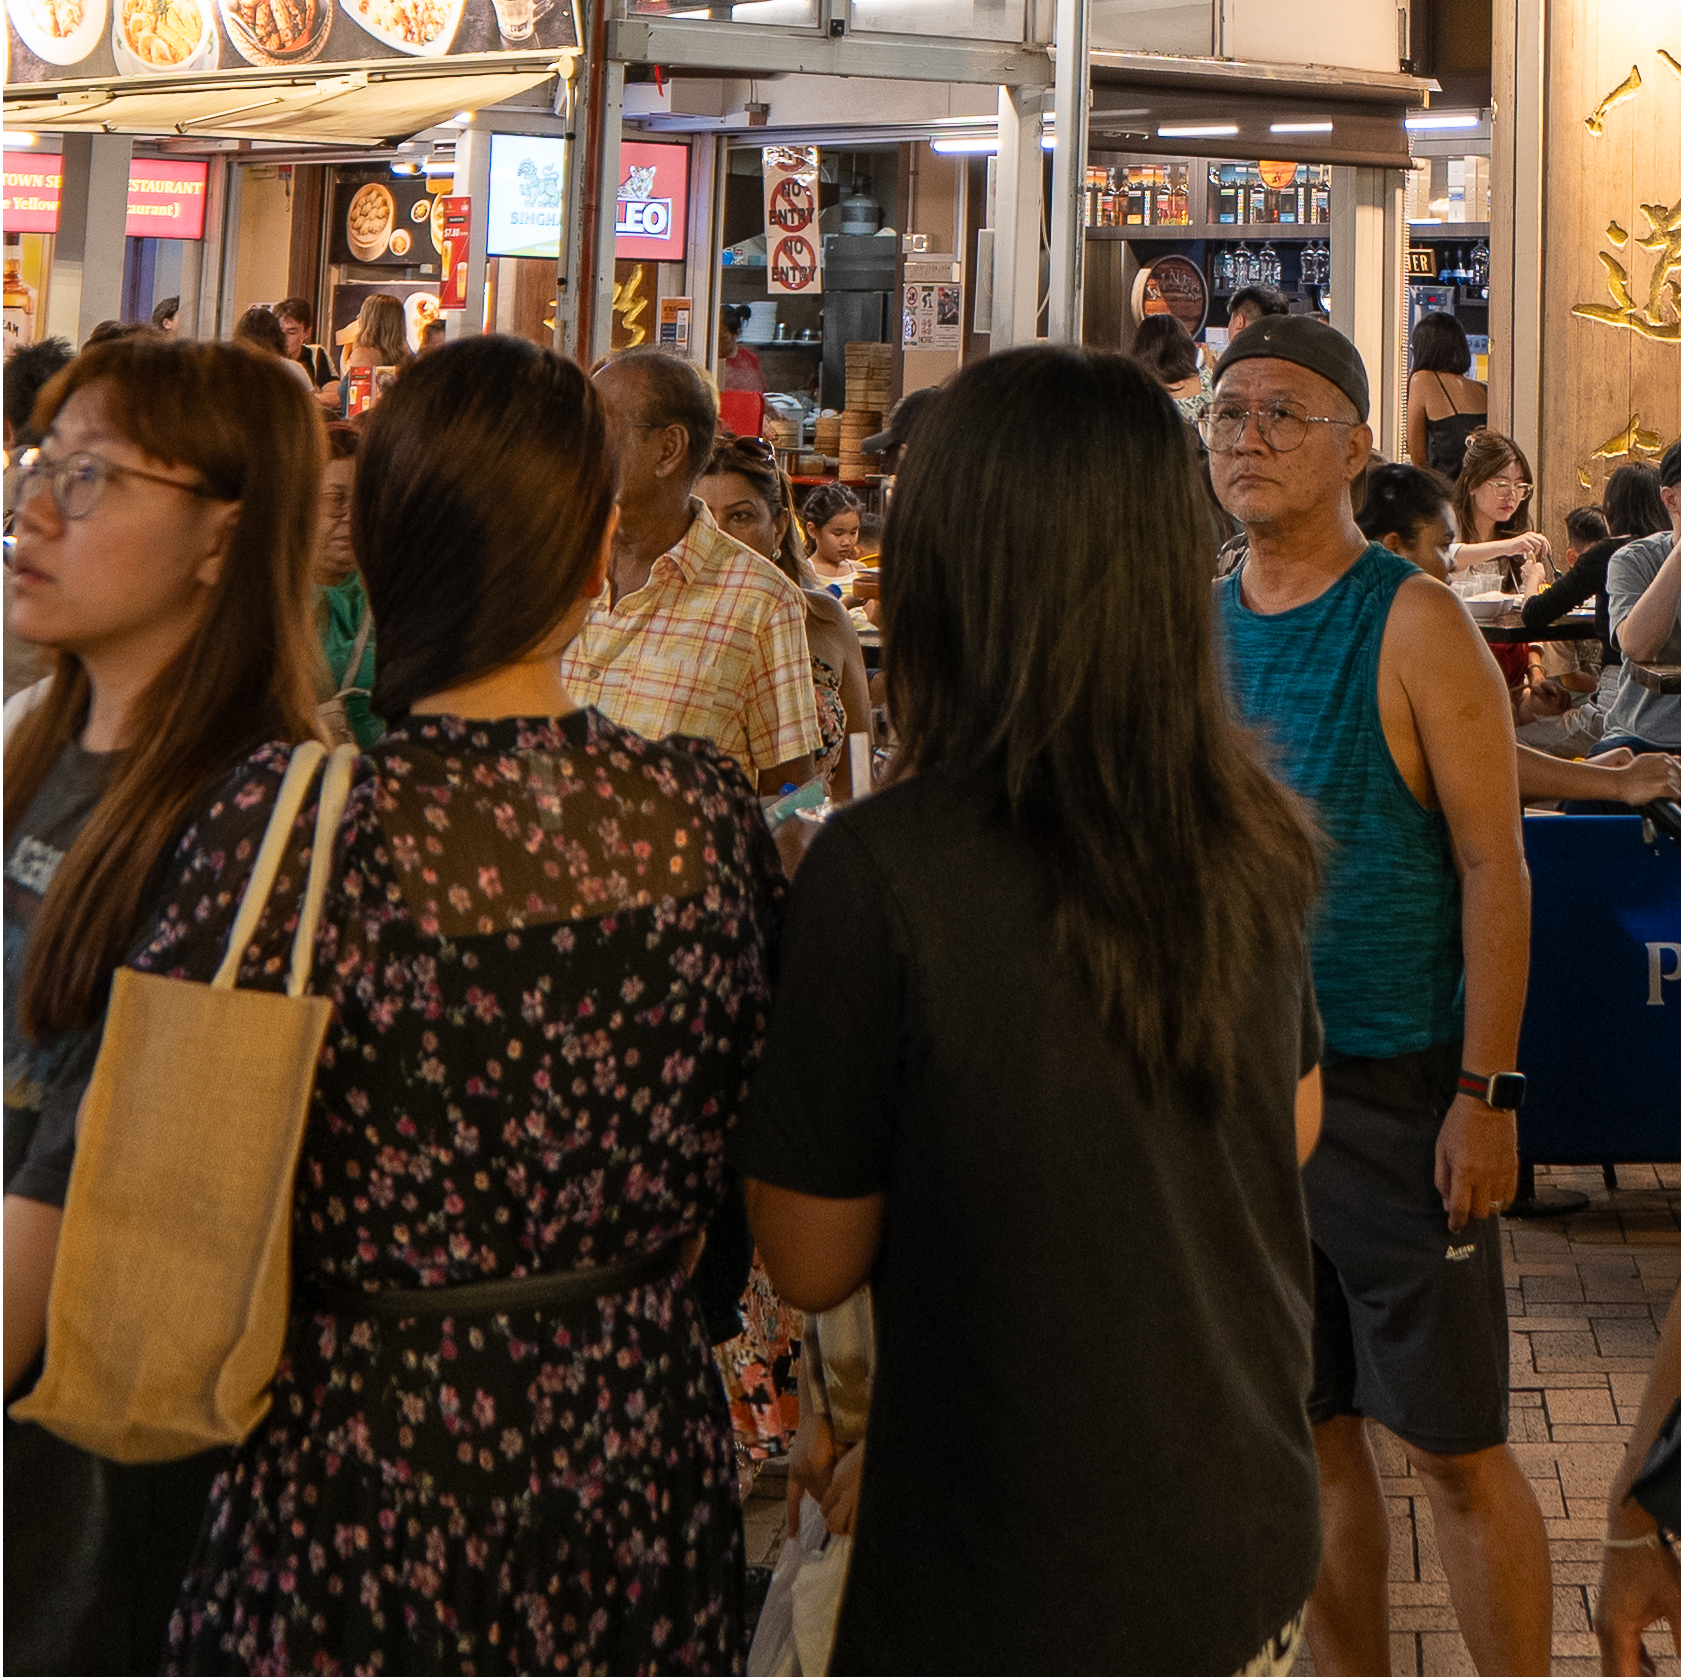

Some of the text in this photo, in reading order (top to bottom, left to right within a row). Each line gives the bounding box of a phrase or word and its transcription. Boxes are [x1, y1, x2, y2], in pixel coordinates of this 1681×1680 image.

[782, 182, 801, 198] NO
[768, 207, 815, 226] ENTRY
[784, 239, 804, 255] NO
[771, 265, 818, 283] ENTRY
